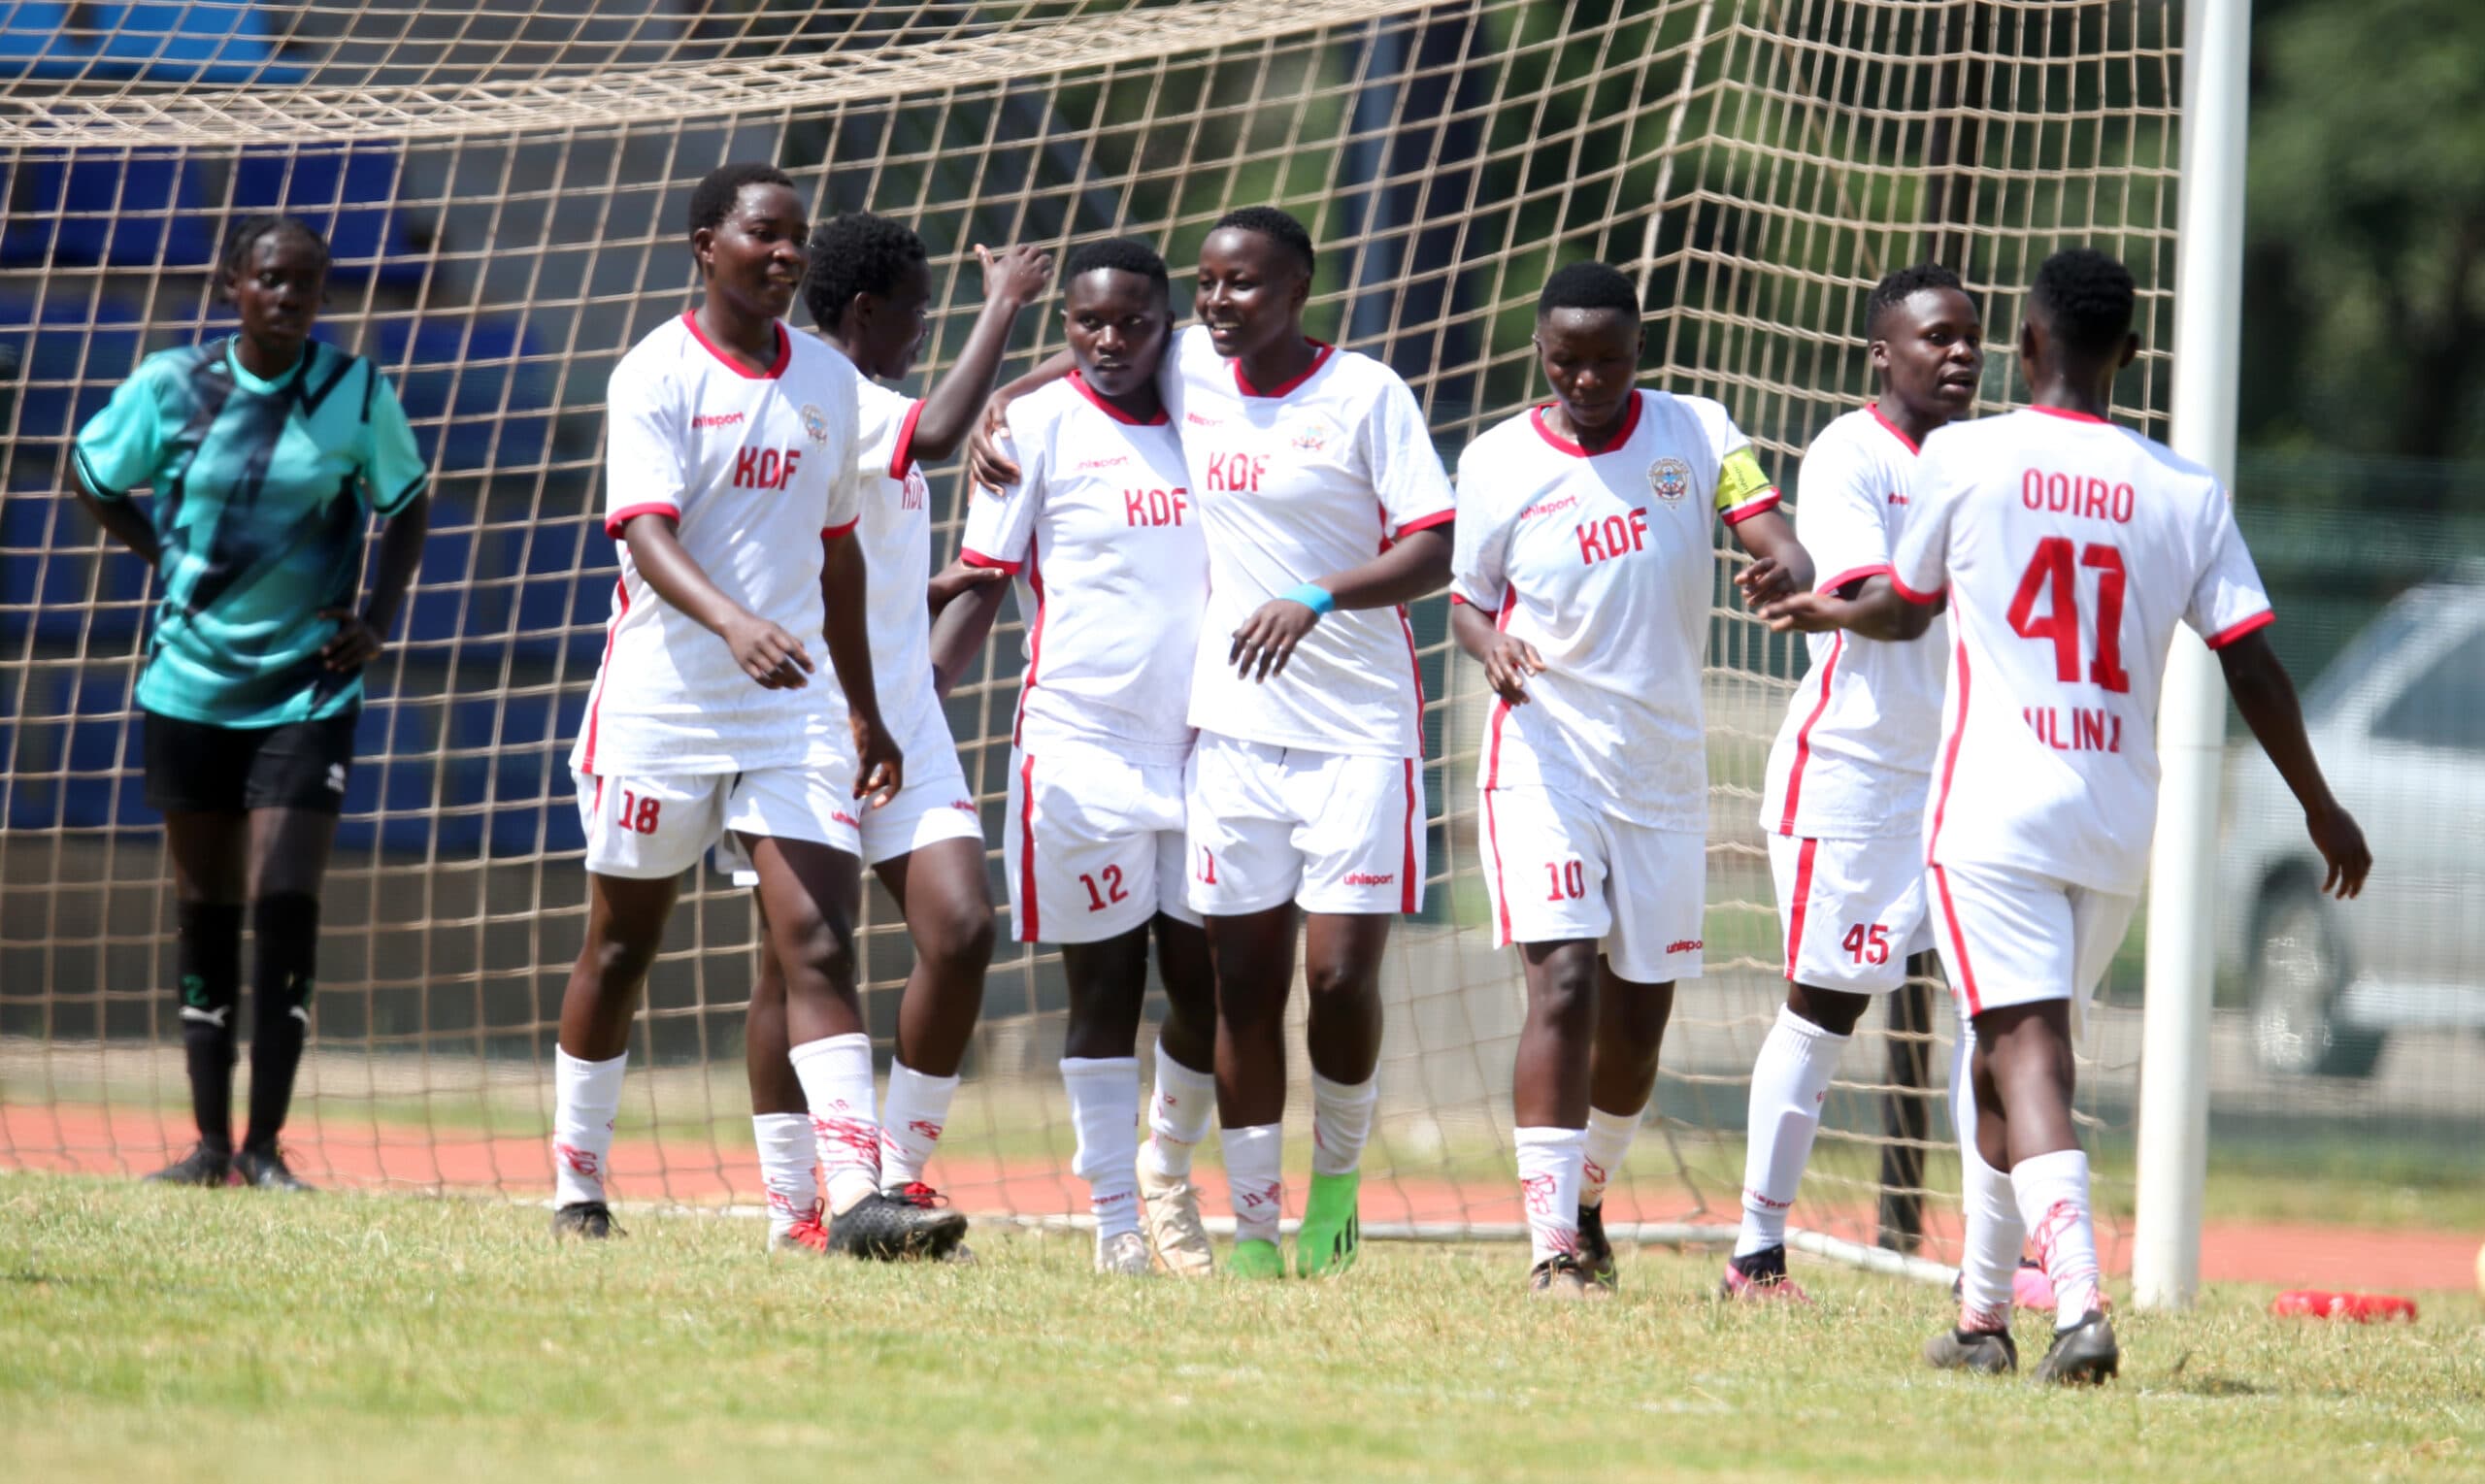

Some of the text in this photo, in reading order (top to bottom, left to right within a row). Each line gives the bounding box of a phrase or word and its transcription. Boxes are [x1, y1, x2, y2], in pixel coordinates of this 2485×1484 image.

[733, 446, 802, 491] KDF
[1207, 452, 1270, 493] KDF
[1124, 487, 1188, 527] KDF
[2022, 468, 2136, 525] ODIRO
[1576, 507, 1648, 566] KDF
[2005, 536, 2131, 694] 41
[617, 789, 661, 836] 18
[1079, 864, 1129, 912] 12
[1544, 861, 1586, 902] 10
[1666, 940, 1703, 954] uhlspo
[1842, 923, 1890, 965] 45
